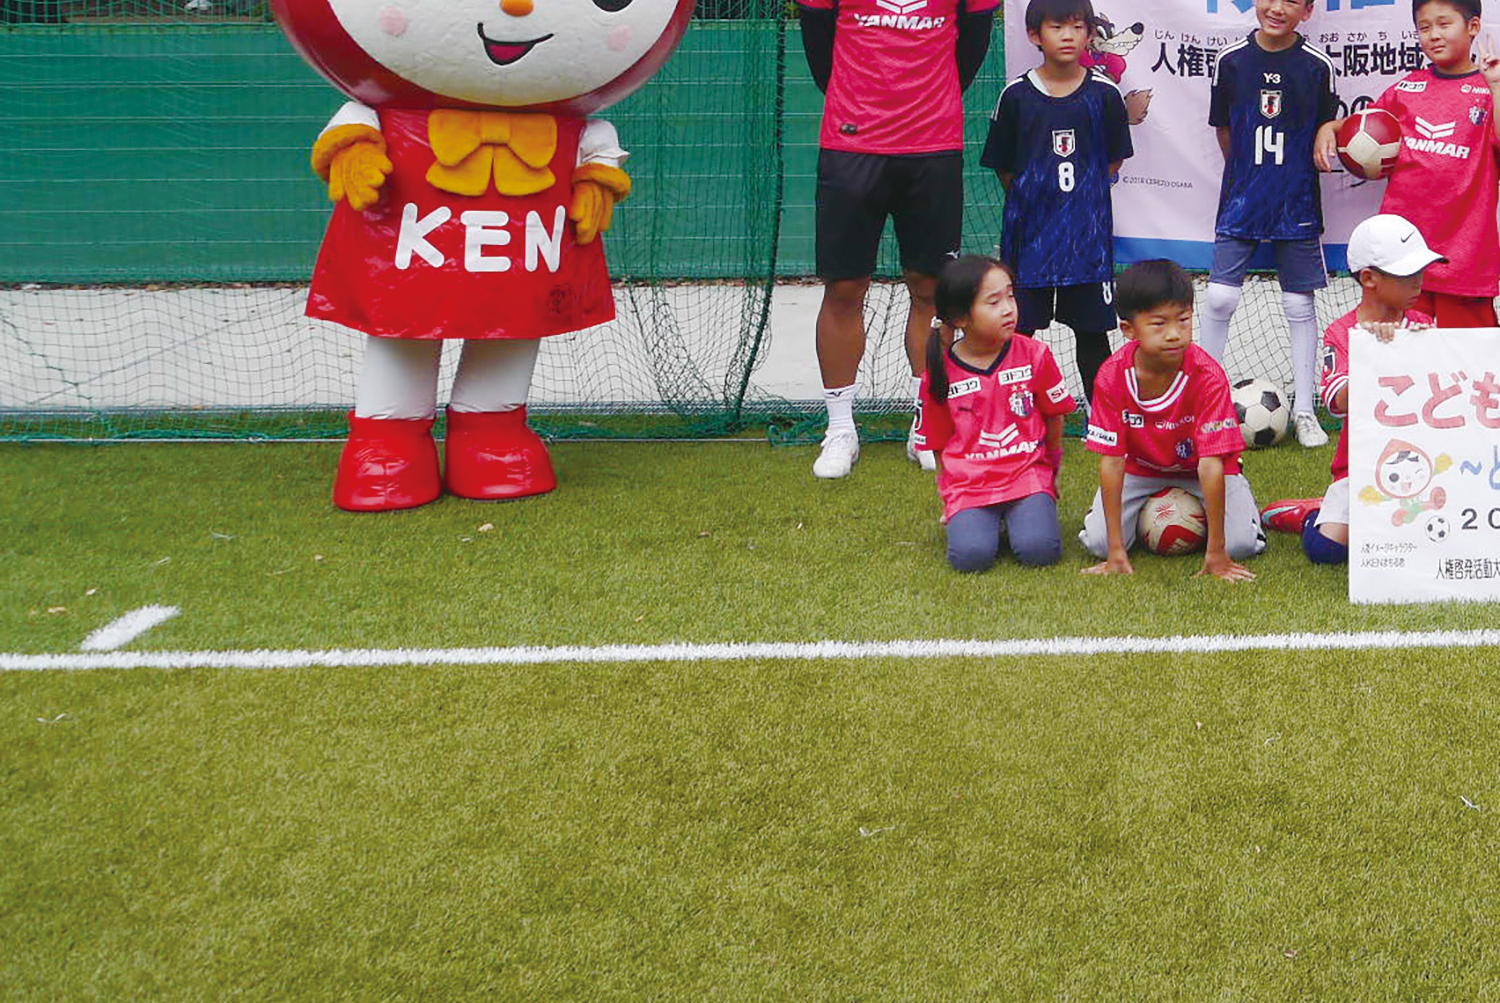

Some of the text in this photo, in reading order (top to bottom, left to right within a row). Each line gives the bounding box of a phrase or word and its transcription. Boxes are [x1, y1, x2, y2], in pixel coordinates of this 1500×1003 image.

[853, 12, 946, 30] YANMAR
[1263, 72, 1282, 84] Y-3
[1254, 125, 1285, 165] 14
[1058, 161, 1076, 193] 8
[394, 202, 566, 273] KEN
